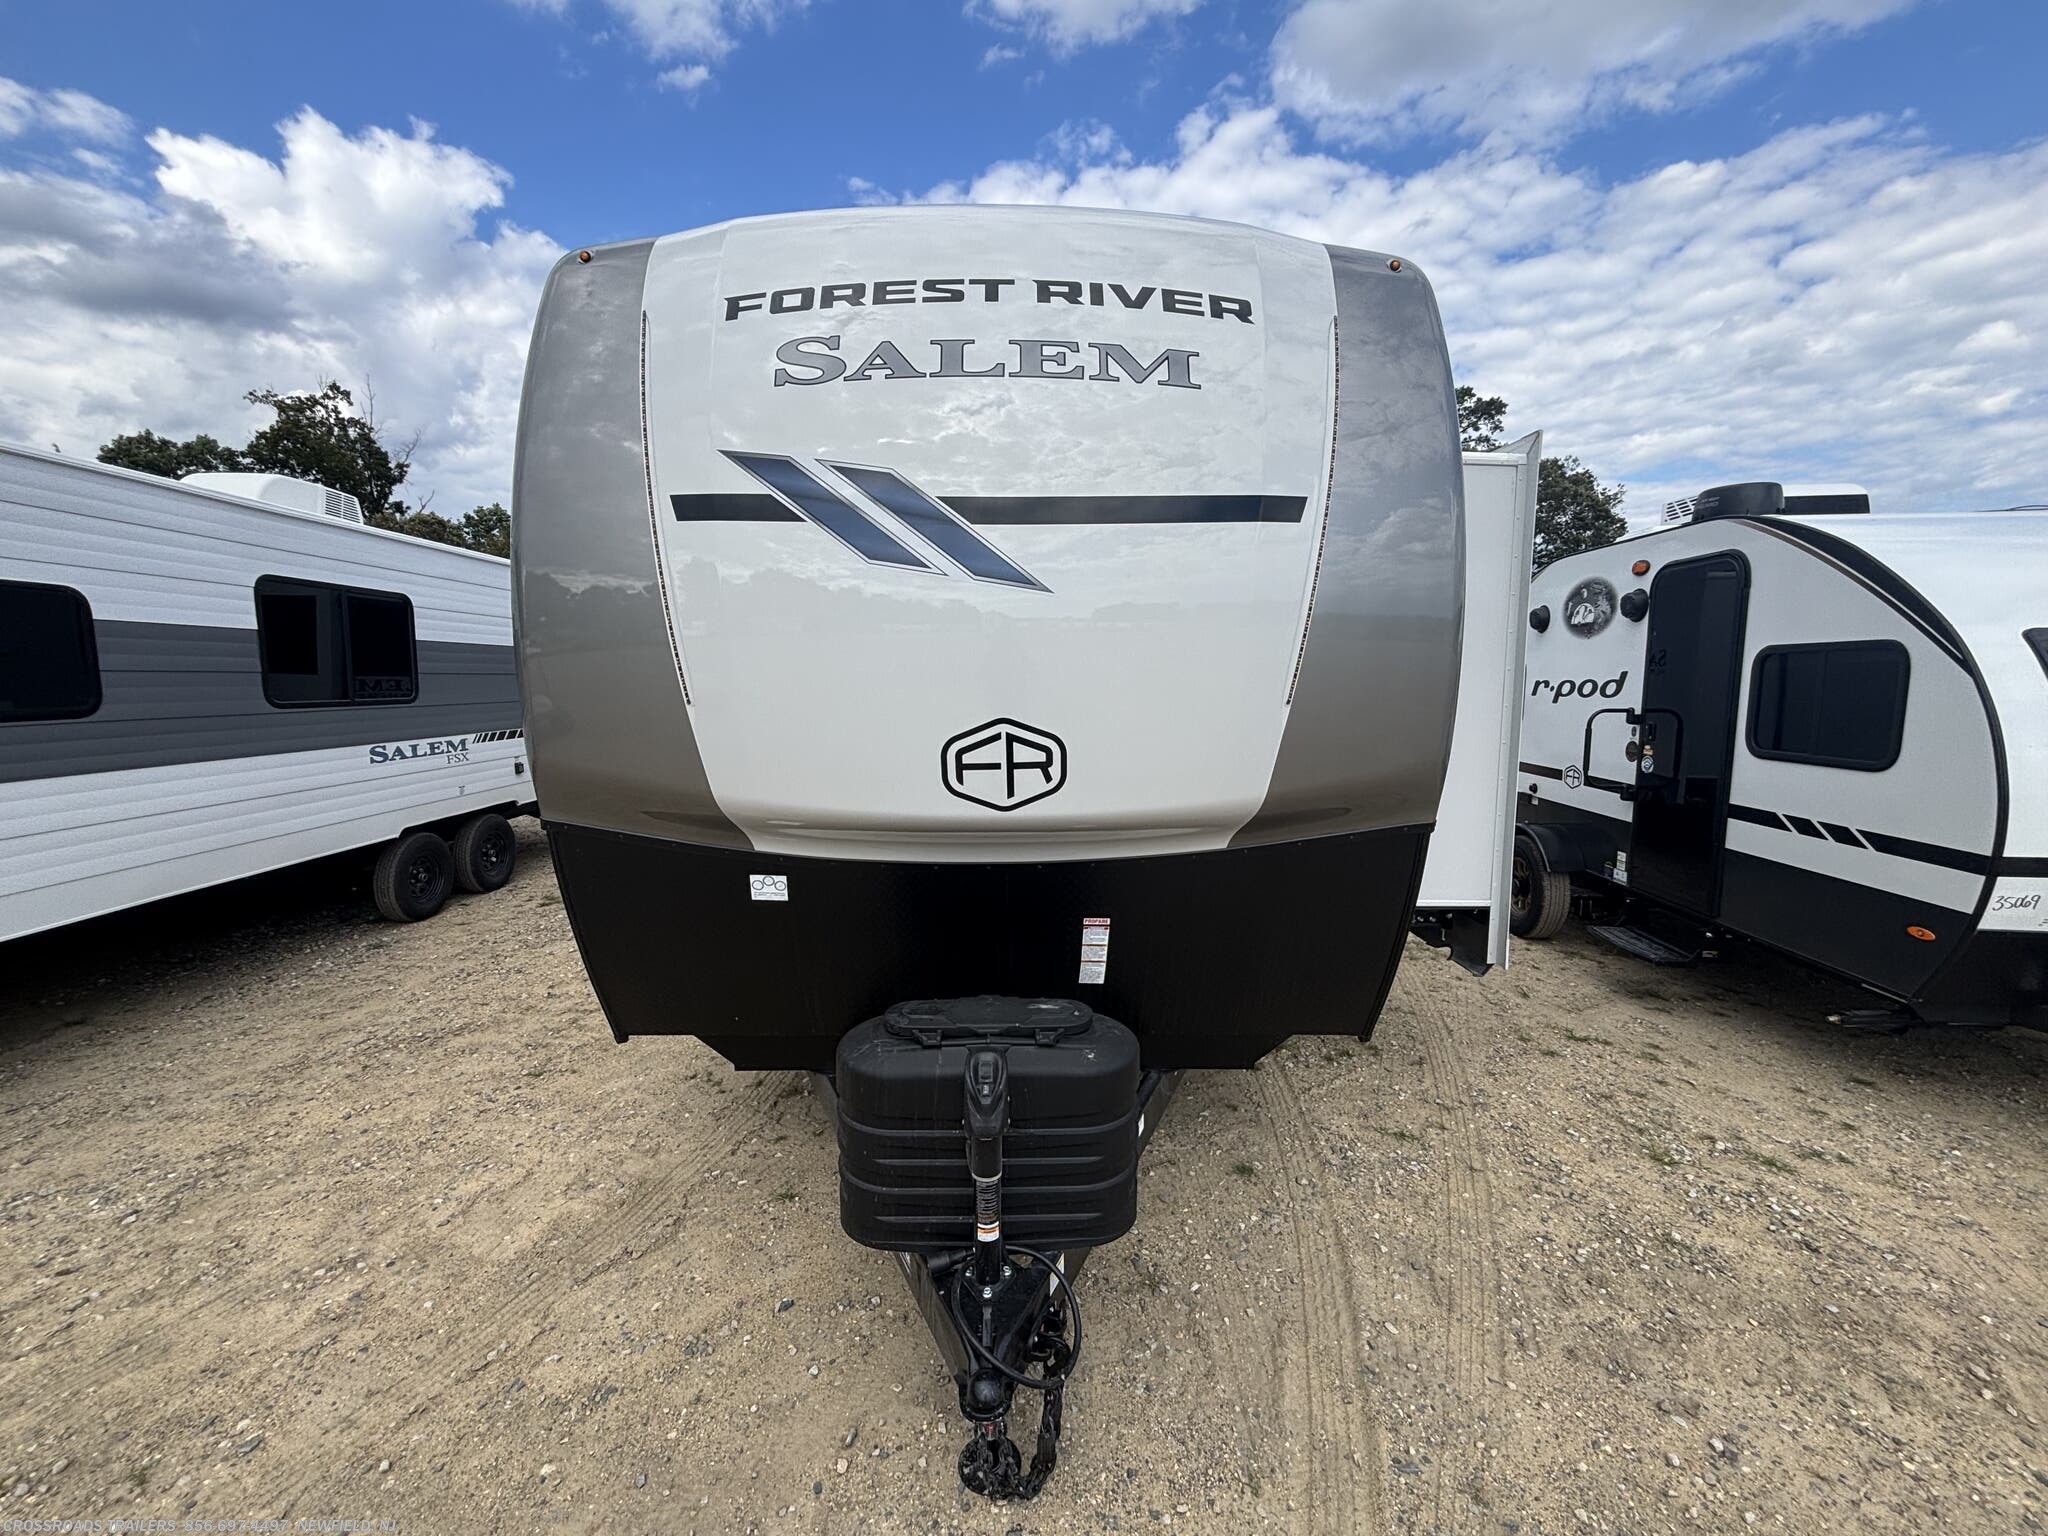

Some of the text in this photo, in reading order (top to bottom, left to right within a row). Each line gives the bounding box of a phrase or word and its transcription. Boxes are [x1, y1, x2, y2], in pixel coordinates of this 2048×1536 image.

[724, 278, 1255, 324] FOREST RIVER
[774, 335, 1202, 389] SALEM
[369, 738, 469, 764] SALEM
[446, 752, 469, 764] FSX
[955, 731, 1053, 799] FR
[1992, 894, 2041, 911] 35069
